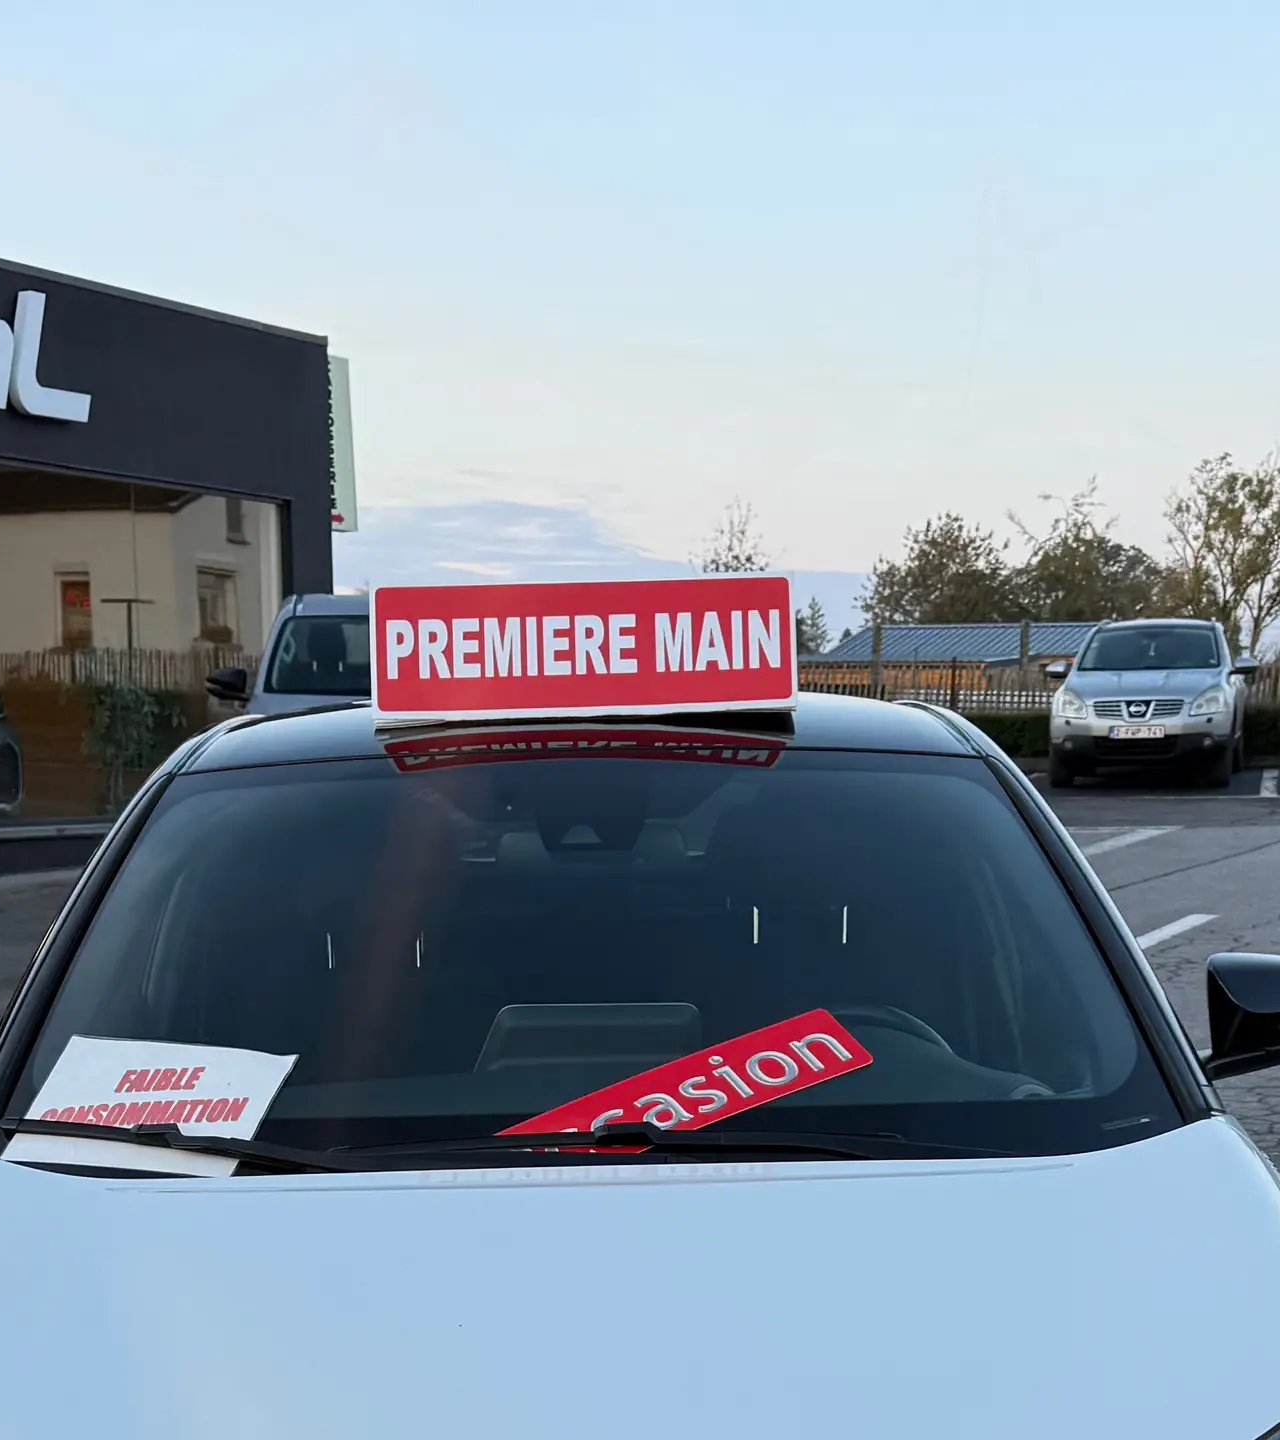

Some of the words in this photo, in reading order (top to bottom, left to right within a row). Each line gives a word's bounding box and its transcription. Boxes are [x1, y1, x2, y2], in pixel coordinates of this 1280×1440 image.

[386, 613, 638, 680] PREMIERE
[654, 608, 781, 673] MAIN
[114, 1066, 206, 1093] FAIBLE
